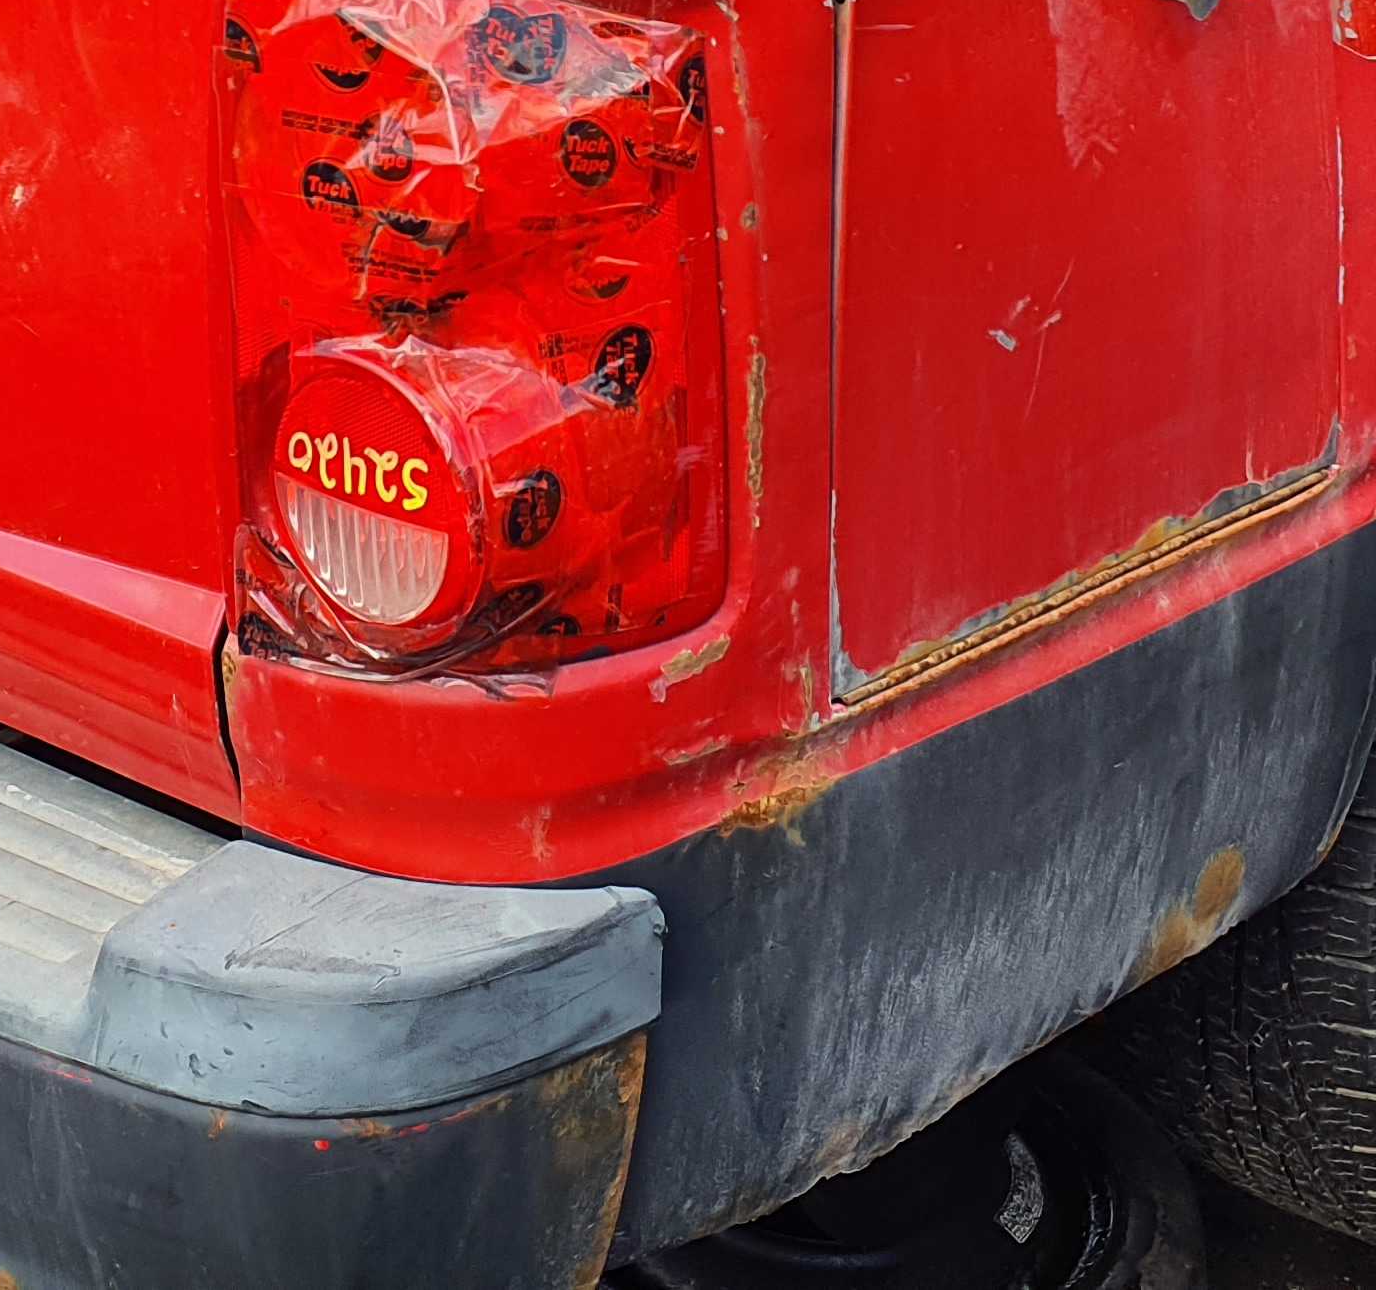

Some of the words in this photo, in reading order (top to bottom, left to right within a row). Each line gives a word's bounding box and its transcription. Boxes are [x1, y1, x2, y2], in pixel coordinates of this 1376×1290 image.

[566, 135, 611, 153] Tuck
[569, 155, 611, 175] Tape
[307, 175, 352, 199] Tuck
